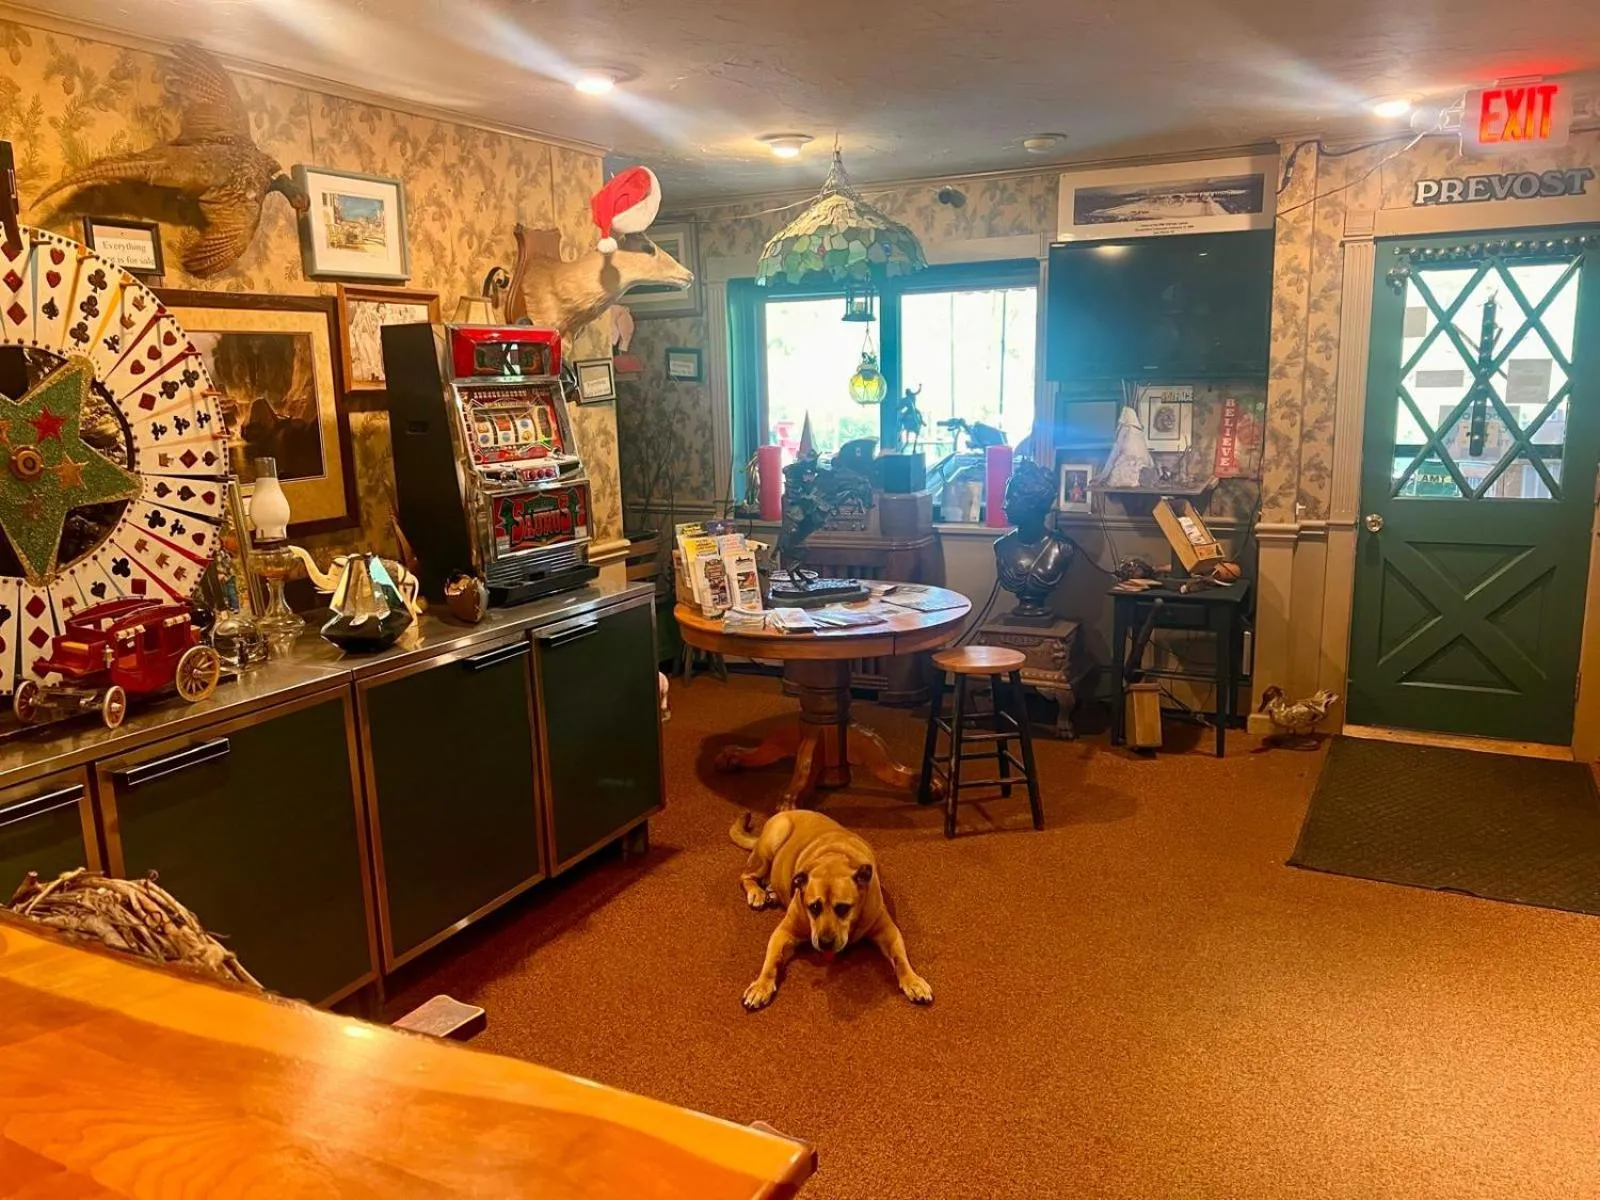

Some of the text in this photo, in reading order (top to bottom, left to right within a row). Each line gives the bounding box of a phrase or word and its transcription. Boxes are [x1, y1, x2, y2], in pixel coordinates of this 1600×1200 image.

[1478, 85, 1560, 144] EXIT
[1414, 168, 1595, 206] PREVOST
[102, 240, 146, 253] Everything
[1220, 398, 1236, 466] BELIEVE
